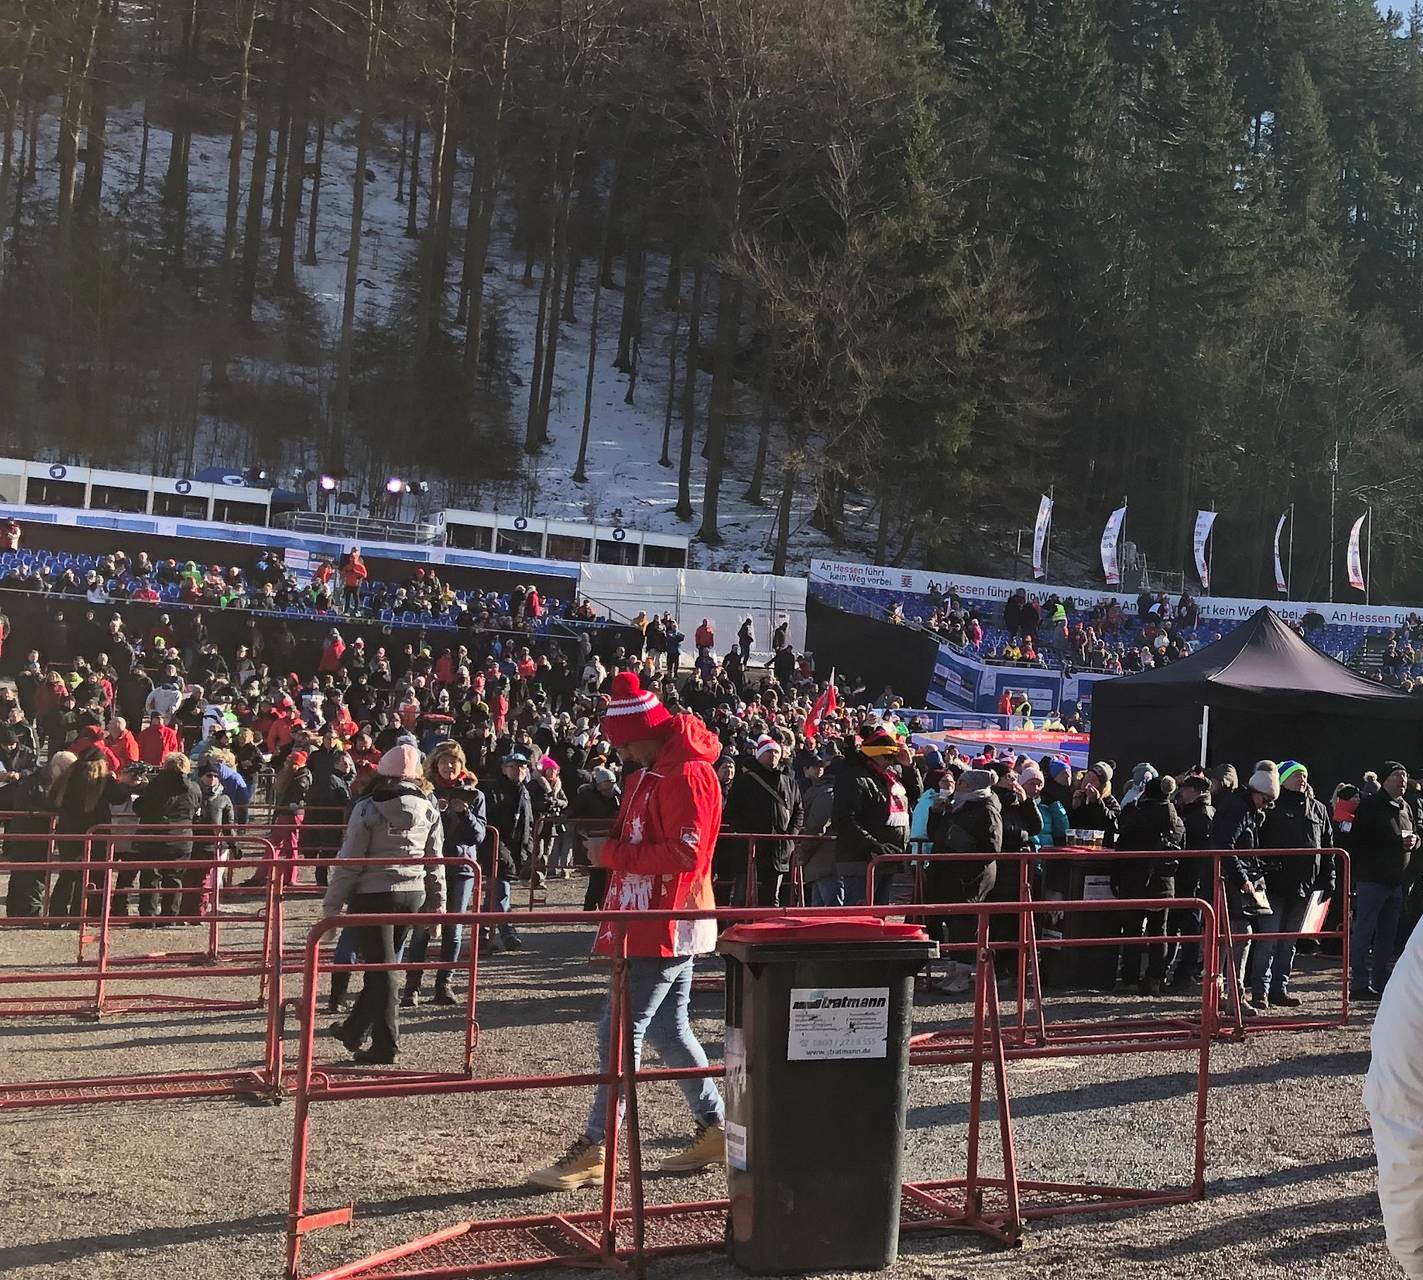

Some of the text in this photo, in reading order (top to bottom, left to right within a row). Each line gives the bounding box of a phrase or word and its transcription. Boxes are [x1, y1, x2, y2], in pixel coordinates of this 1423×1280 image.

[820, 562, 885, 577] An Hessen führt
[829, 572, 847, 582] kein
[848, 573, 866, 585] Weg
[1122, 601, 1137, 611] An
[1212, 605, 1236, 616] kein
[1331, 610, 1347, 622] An
[1350, 611, 1391, 624] Hessen
